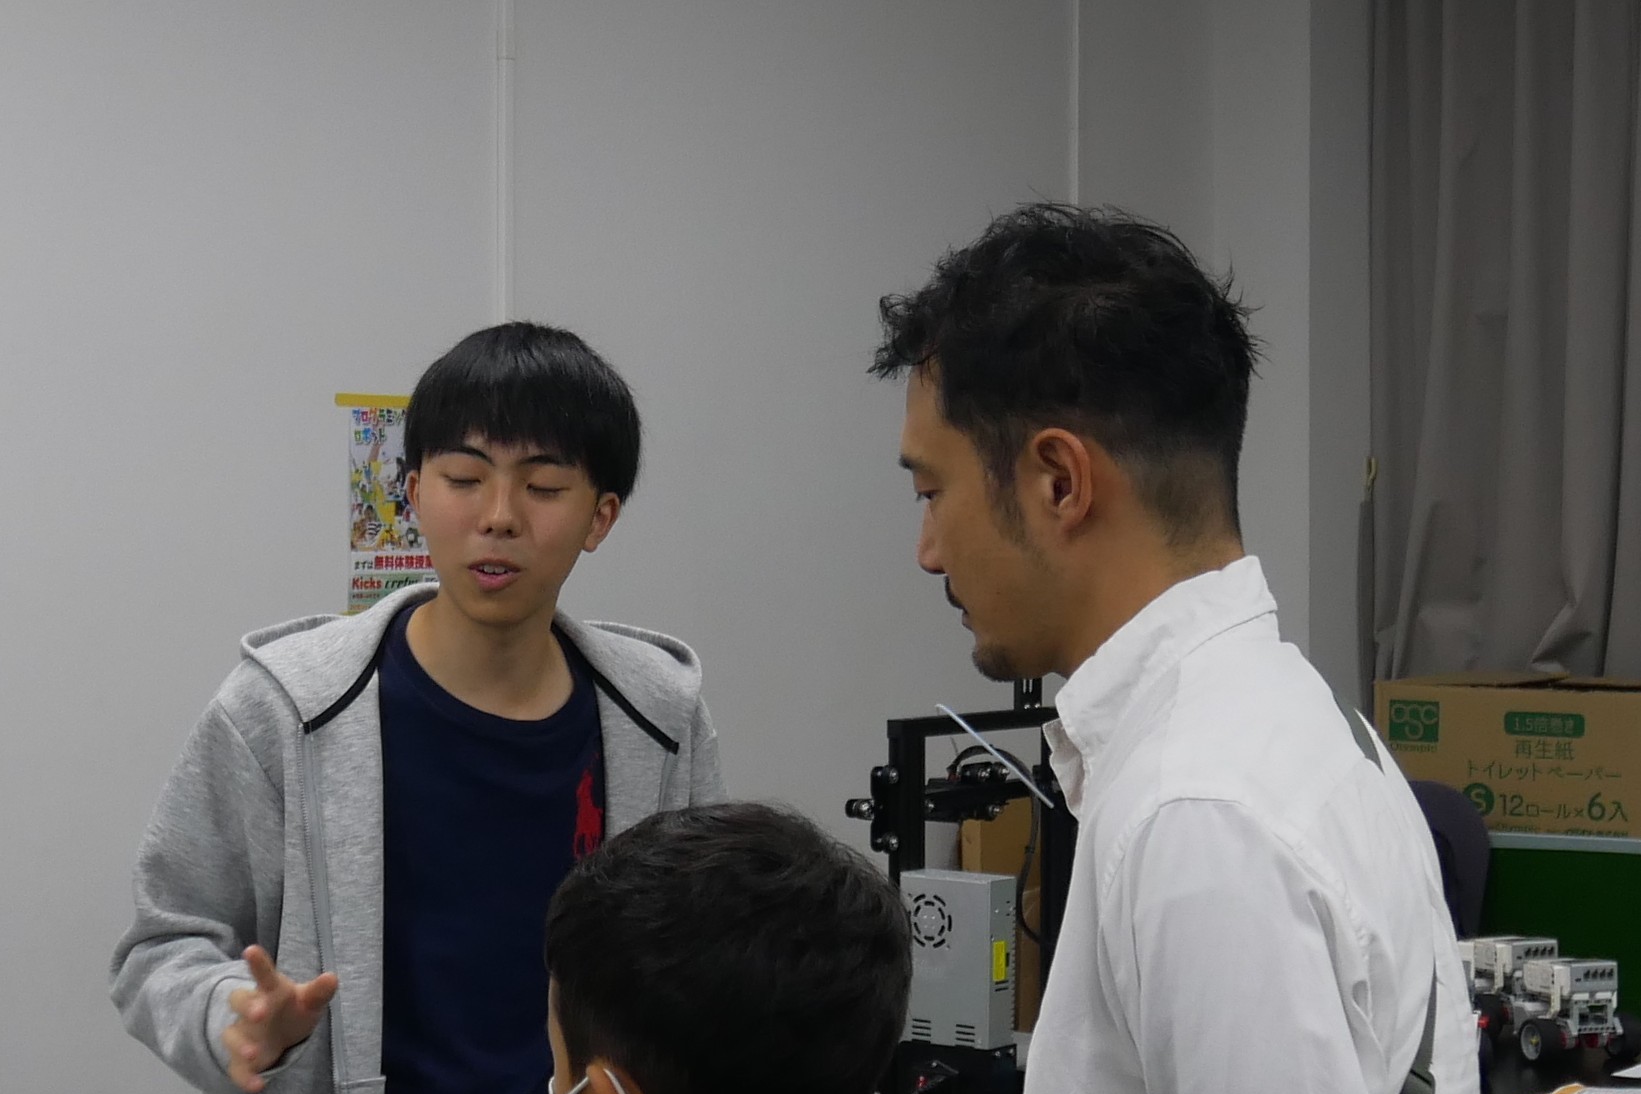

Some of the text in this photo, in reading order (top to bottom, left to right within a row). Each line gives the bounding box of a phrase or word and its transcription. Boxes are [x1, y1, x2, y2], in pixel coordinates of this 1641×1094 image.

[352, 577, 382, 590] Kicks
[1515, 738, 1576, 760] 再生紙
[1467, 759, 1622, 781] トイレットペーパー
